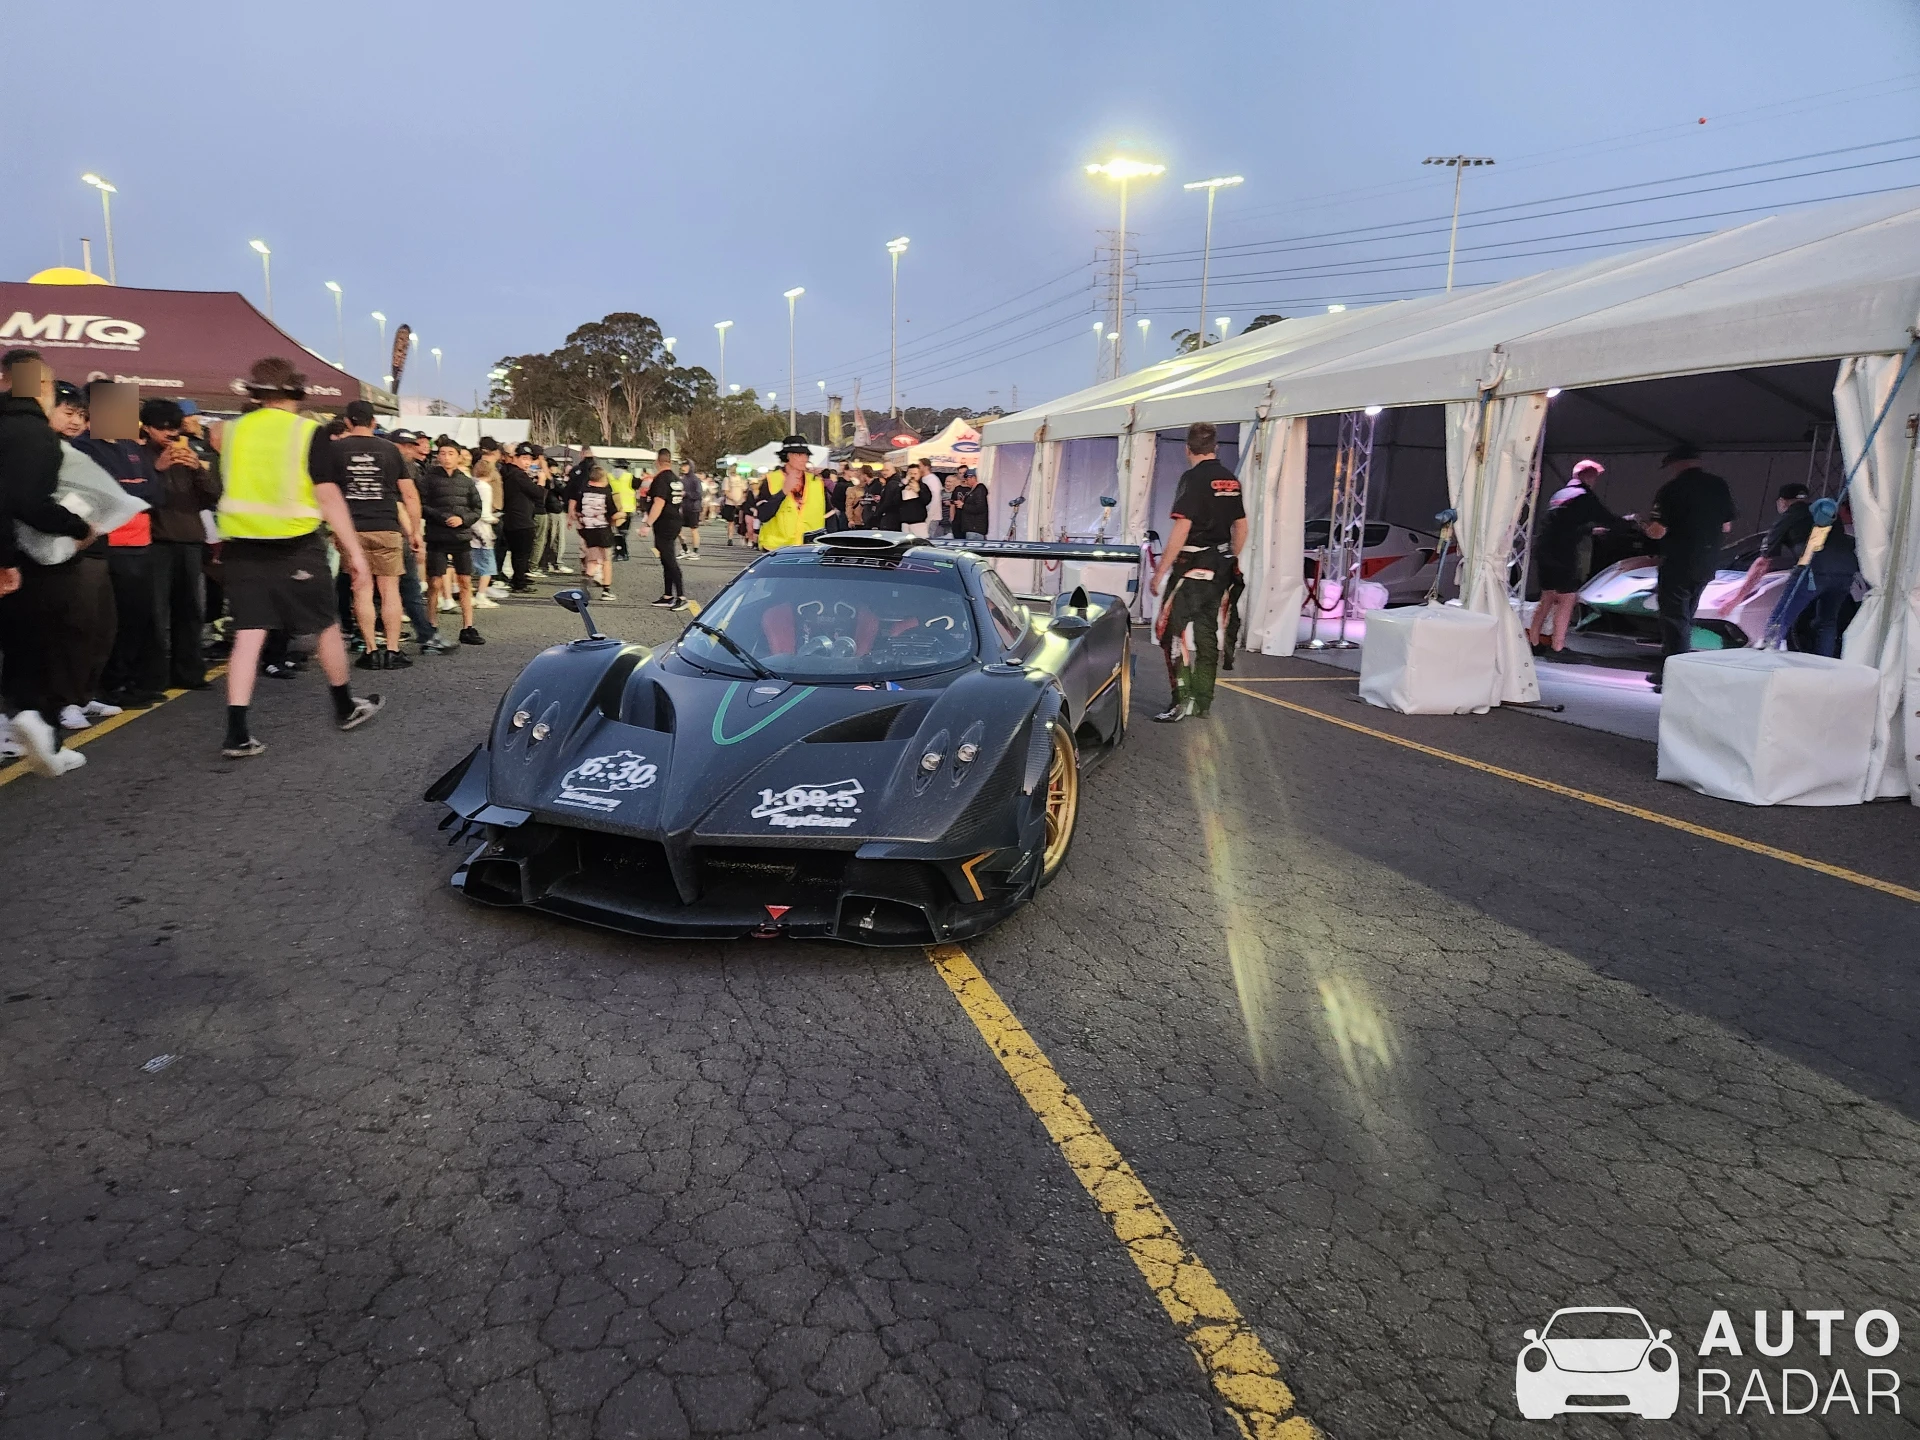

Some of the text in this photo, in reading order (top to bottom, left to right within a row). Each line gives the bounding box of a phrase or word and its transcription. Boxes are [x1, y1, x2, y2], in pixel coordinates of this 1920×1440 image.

[0, 311, 146, 345] MTQ
[797, 556, 913, 570] PAGANI
[579, 758, 658, 784] 6:30
[768, 813, 858, 828] TopGear
